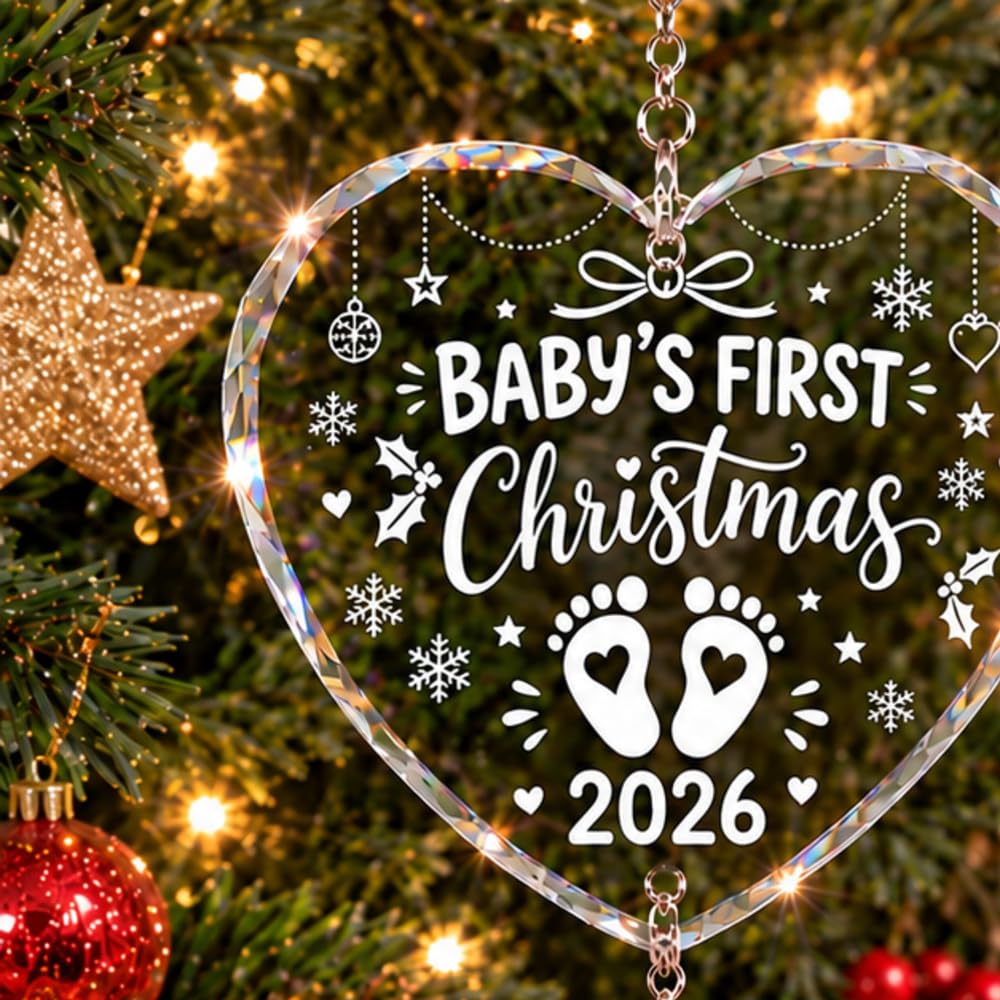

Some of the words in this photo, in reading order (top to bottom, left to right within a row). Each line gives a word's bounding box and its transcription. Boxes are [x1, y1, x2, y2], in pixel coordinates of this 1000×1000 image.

[435, 321, 694, 435] BABY'S
[717, 335, 904, 428] FIRST
[442, 425, 941, 595] Christmas
[568, 768, 766, 846] 2026
